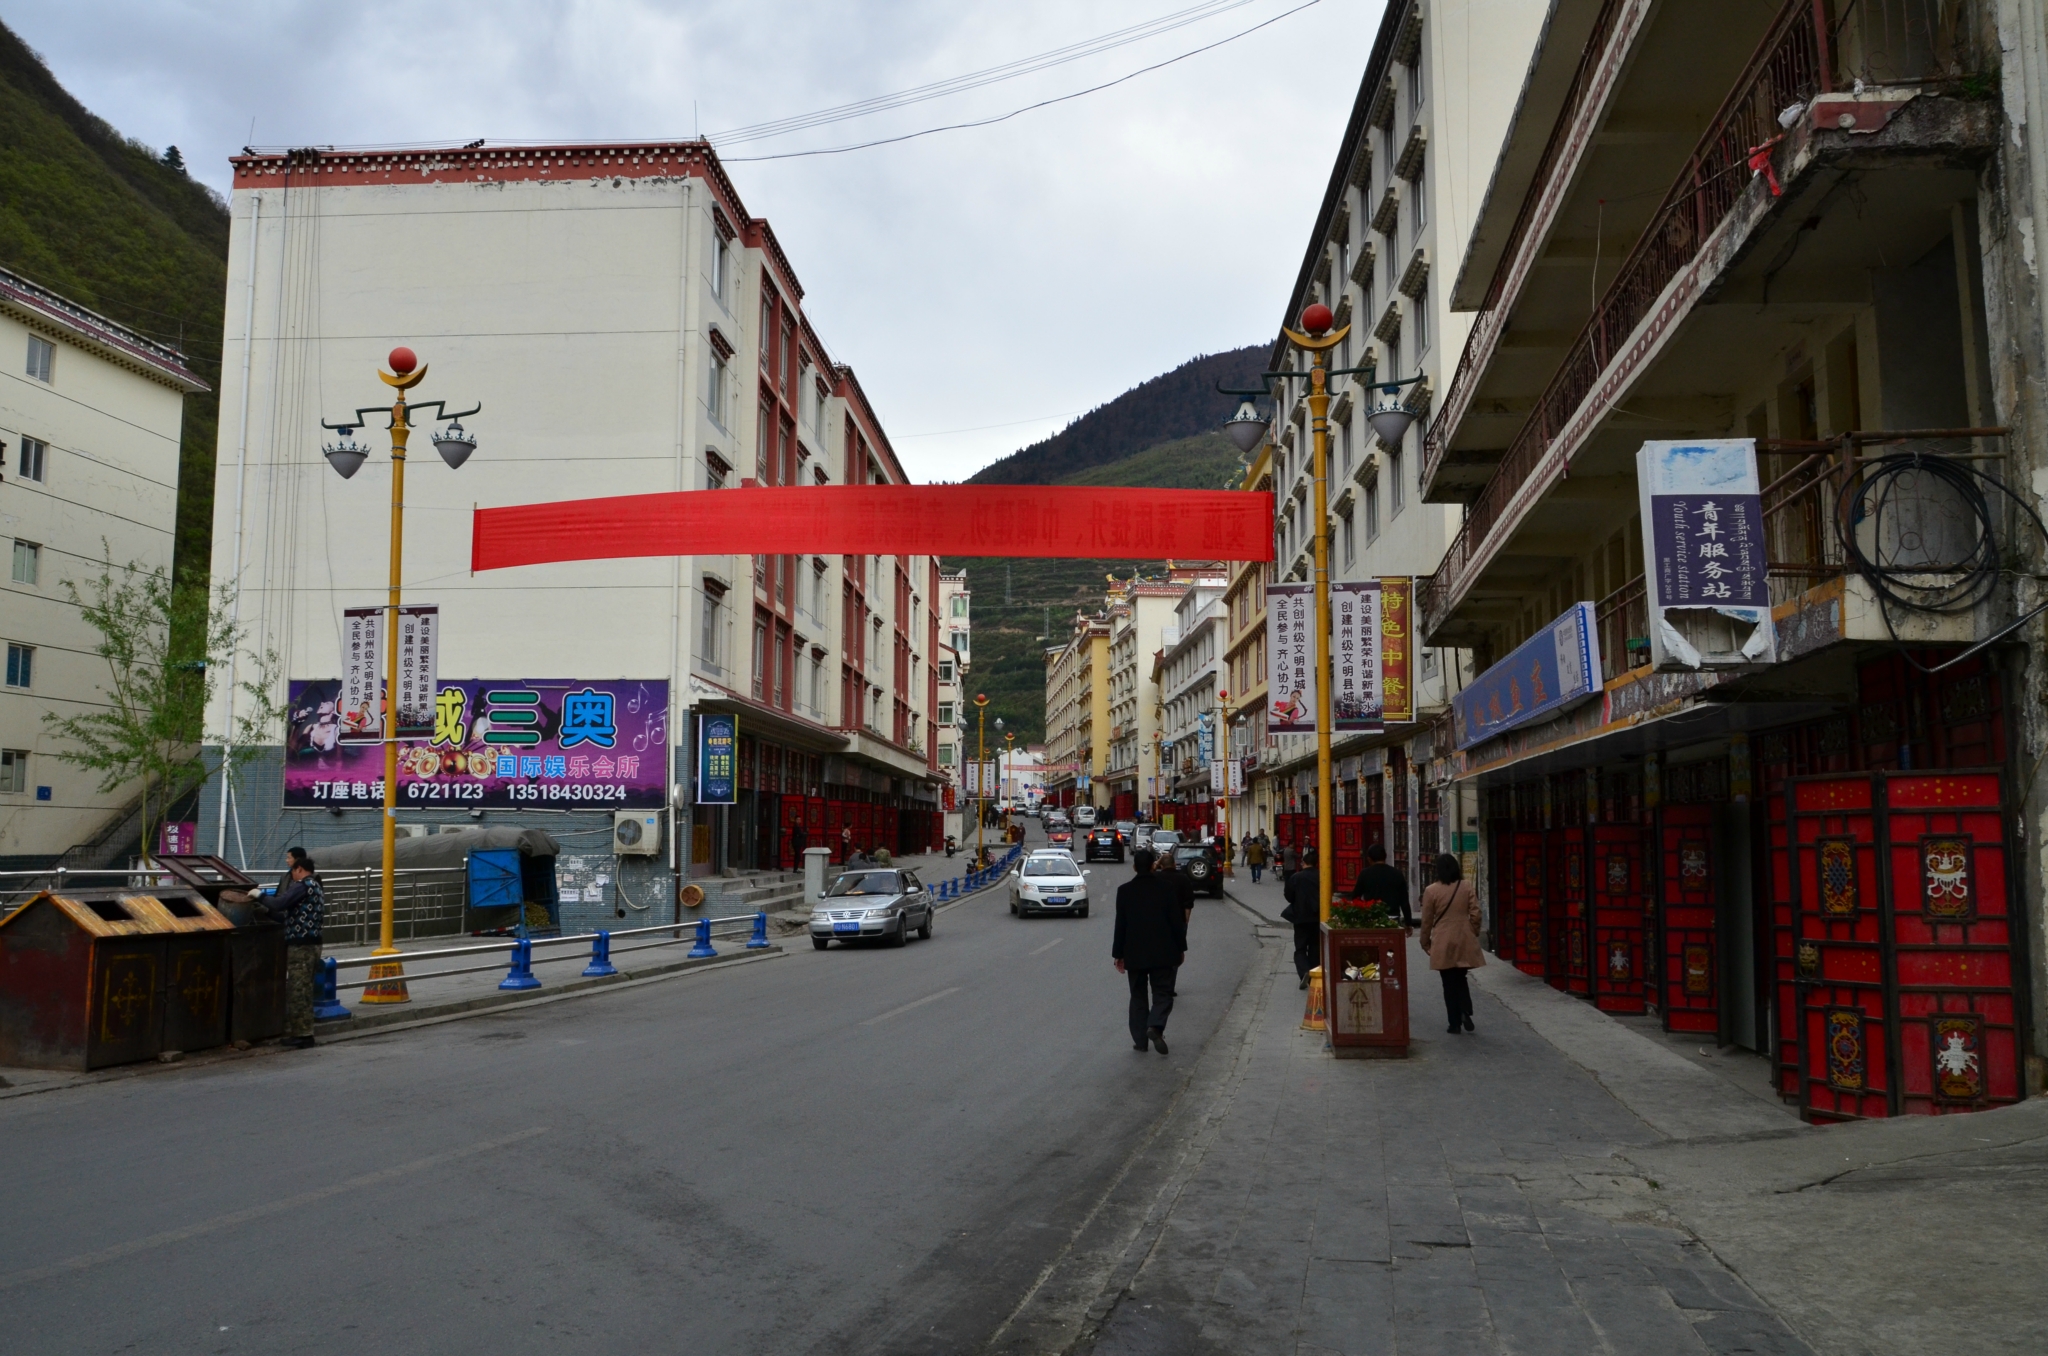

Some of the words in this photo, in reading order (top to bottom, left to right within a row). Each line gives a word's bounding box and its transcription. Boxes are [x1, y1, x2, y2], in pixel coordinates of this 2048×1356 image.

[1673, 500, 1690, 529] Youth
[1675, 531, 1691, 563] service
[1692, 501, 1733, 598] 青年服务站
[1678, 564, 1690, 599] station
[351, 620, 361, 661] 全民参与
[1276, 599, 1288, 644] 全民参与
[1293, 597, 1306, 690] 共创州级文明县城
[1380, 591, 1405, 695] 特色中餐
[363, 619, 375, 701] 共创州级文明县城
[402, 623, 414, 713] 创建州级文明县城
[418, 617, 430, 722] 建设美丽繁荣和谐新黑水
[1277, 649, 1289, 695] 齐心协力
[1341, 601, 1355, 703] 创建州级文明县城
[1360, 594, 1375, 713] 建设美丽繁荣和谐新黑水
[350, 665, 360, 706] 齐心协力
[495, 754, 640, 779] 国际娱乐会所
[312, 780, 386, 800] 订座电话
[408, 783, 484, 799] 6721123
[507, 783, 627, 801] 13518430324
